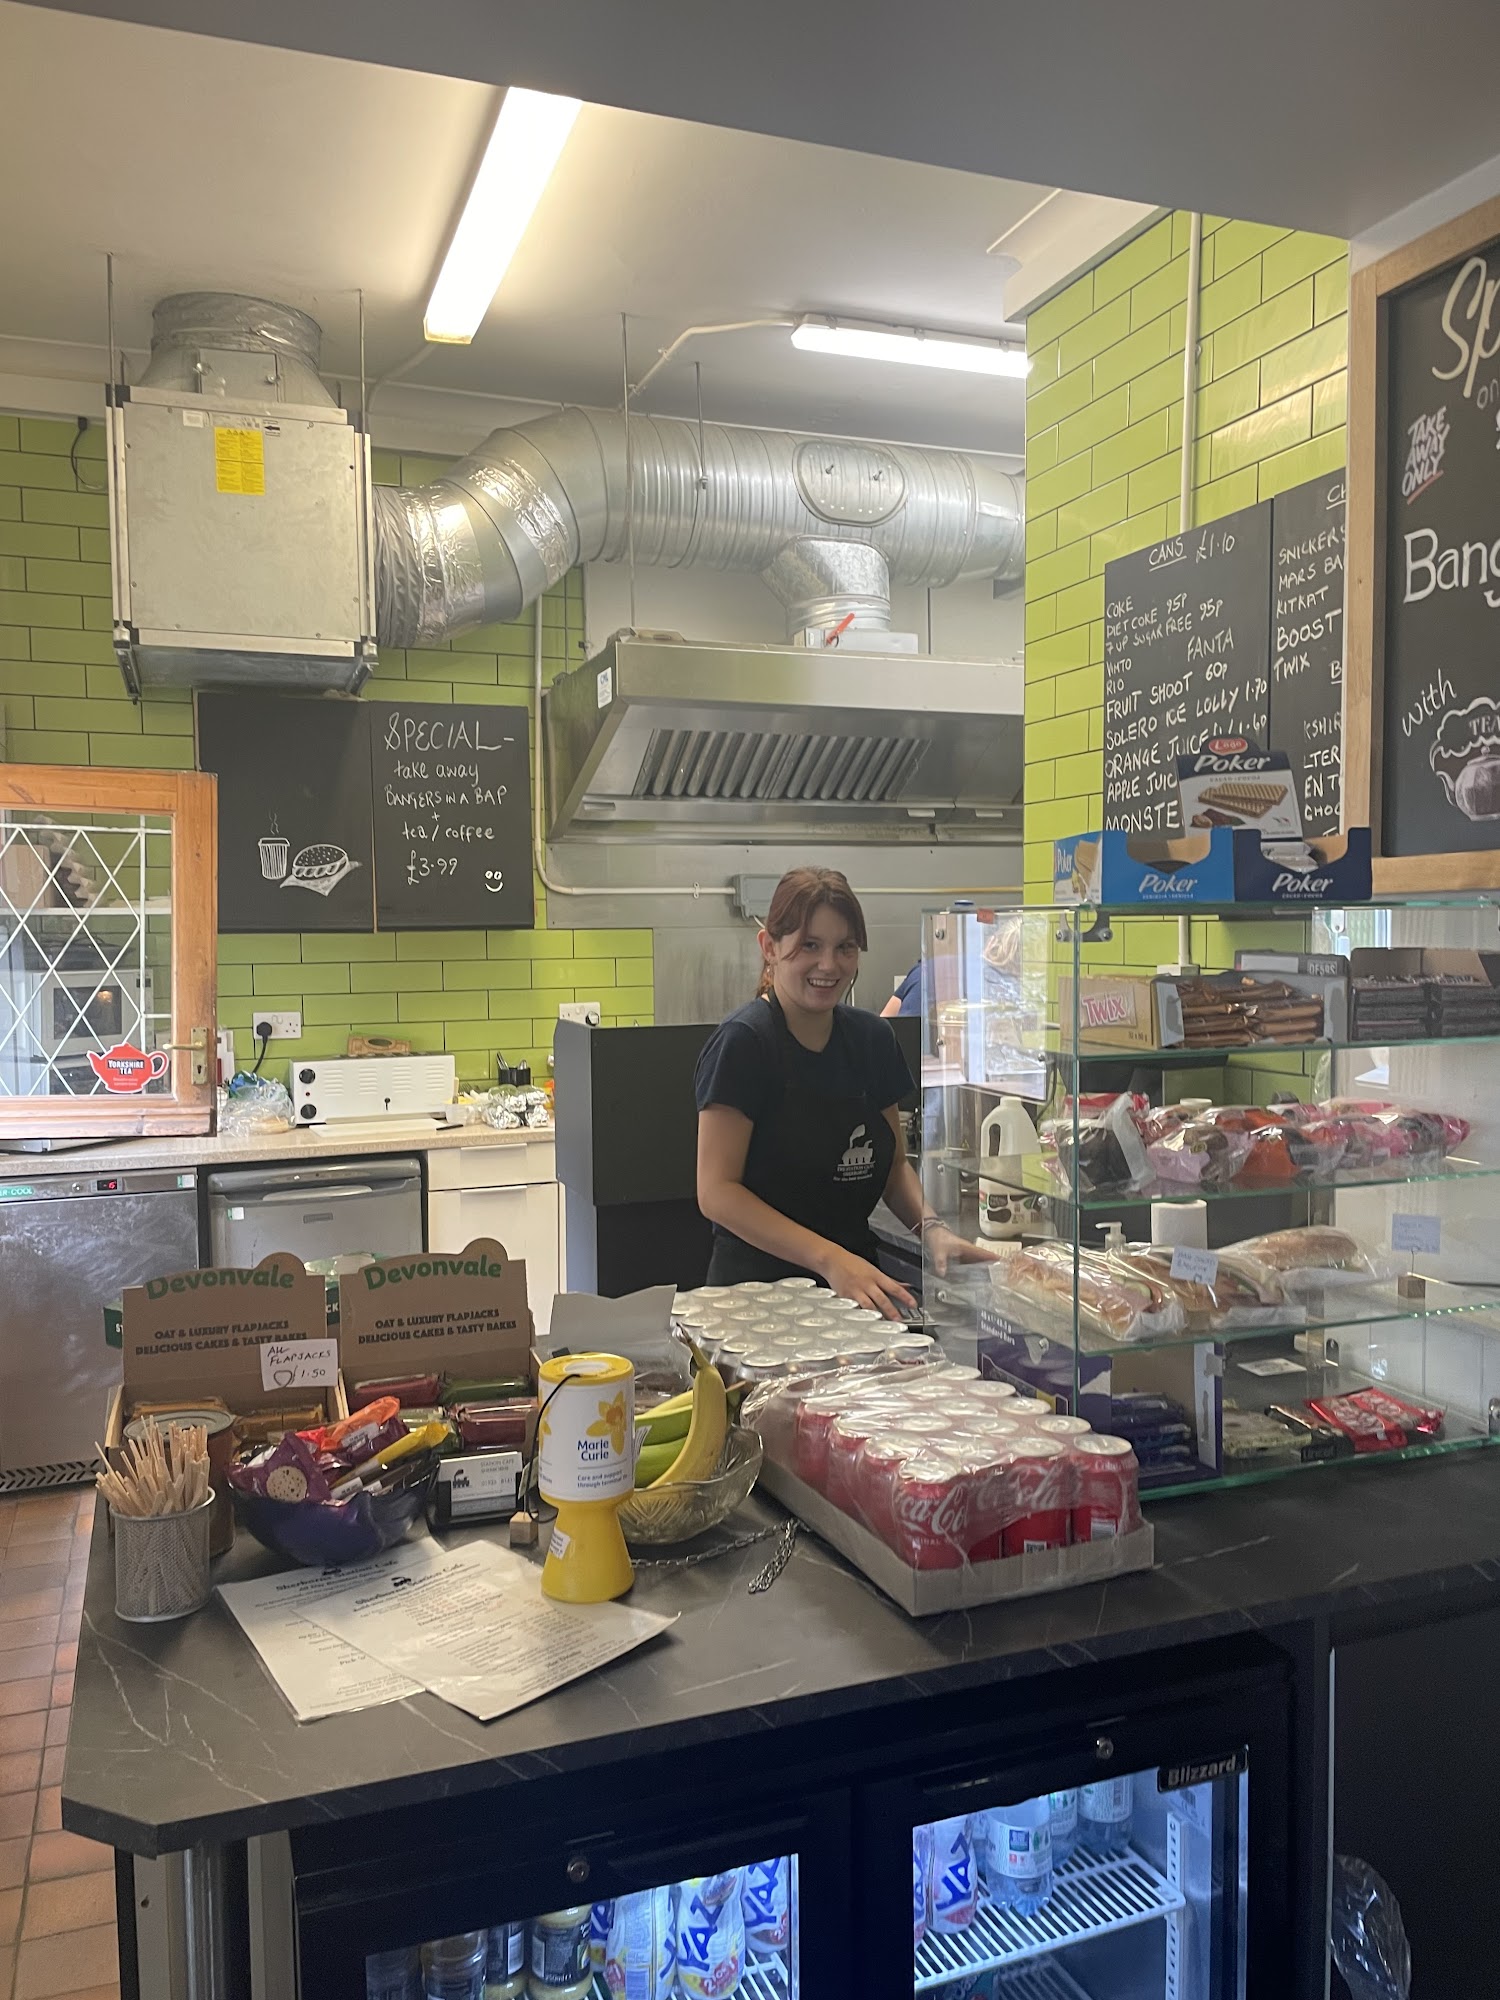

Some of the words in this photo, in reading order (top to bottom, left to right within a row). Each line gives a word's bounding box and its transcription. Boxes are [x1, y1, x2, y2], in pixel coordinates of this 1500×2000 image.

[1407, 405, 1447, 445] TAKE
[1405, 423, 1450, 471] AWAY
[1402, 453, 1442, 496] ONLY
[1149, 537, 1185, 563] CANS
[1279, 562, 1316, 592] MARS
[1324, 554, 1345, 575] BA
[1106, 595, 1134, 619] COKE
[1276, 585, 1329, 619] KITKAT
[1106, 619, 1129, 639] DIET
[1131, 607, 1158, 630] COKE
[1133, 623, 1163, 647] SUGAR
[1166, 613, 1193, 637] FREE
[1277, 608, 1342, 652] BOOST
[1187, 627, 1234, 662] FANTA
[1273, 650, 1310, 684] TWIX
[1106, 678, 1125, 695] RIO
[1106, 690, 1143, 724] FRUIT
[1149, 671, 1194, 706] SHOOT
[1402, 668, 1457, 737] with
[1106, 716, 1158, 751] SOLERO
[1165, 702, 1187, 728] ICE
[1196, 687, 1239, 718] LOLLY
[393, 760, 430, 779] take
[435, 761, 480, 788] away
[1105, 742, 1161, 779] ORANGE
[1193, 754, 1272, 774] Poker
[384, 784, 443, 809] BANGERS
[445, 792, 457, 805] IN
[458, 793, 470, 805] A
[474, 785, 508, 806] BAP
[1106, 776, 1141, 804] APPLE
[1106, 800, 1185, 834] MONSTE
[402, 822, 428, 842] tea
[445, 822, 496, 843] coffee
[1138, 873, 1198, 894] Poker
[1272, 873, 1334, 894] Poker
[107, 1059, 145, 1069] YORKSHIRE
[119, 1067, 134, 1076] TEA
[146, 1264, 295, 1300] Devonvale
[364, 1254, 502, 1291] Devonvale
[154, 1328, 176, 1339] OAT
[188, 1324, 230, 1338] LUXURY
[231, 1320, 290, 1334] FLAPJACKS
[358, 1331, 411, 1344] DELICIOUS
[412, 1327, 445, 1339] CAKES
[456, 1323, 484, 1334] TASTY
[486, 1320, 517, 1331] BAKES
[375, 1319, 395, 1329] OAT
[407, 1313, 445, 1326] LUXURY
[446, 1308, 500, 1322] FLAPJACKS
[135, 1342, 193, 1356] DELICIOUS
[194, 1338, 230, 1350] CAKES
[241, 1333, 273, 1346] TASTY
[269, 1350, 331, 1366] FLAPJACKS
[576, 1438, 609, 1451] Marie
[580, 1450, 609, 1461] Curie
[577, 1481, 601, 1489] through
[593, 1472, 603, 1480] and
[1167, 1753, 1237, 1787] Blizzard
